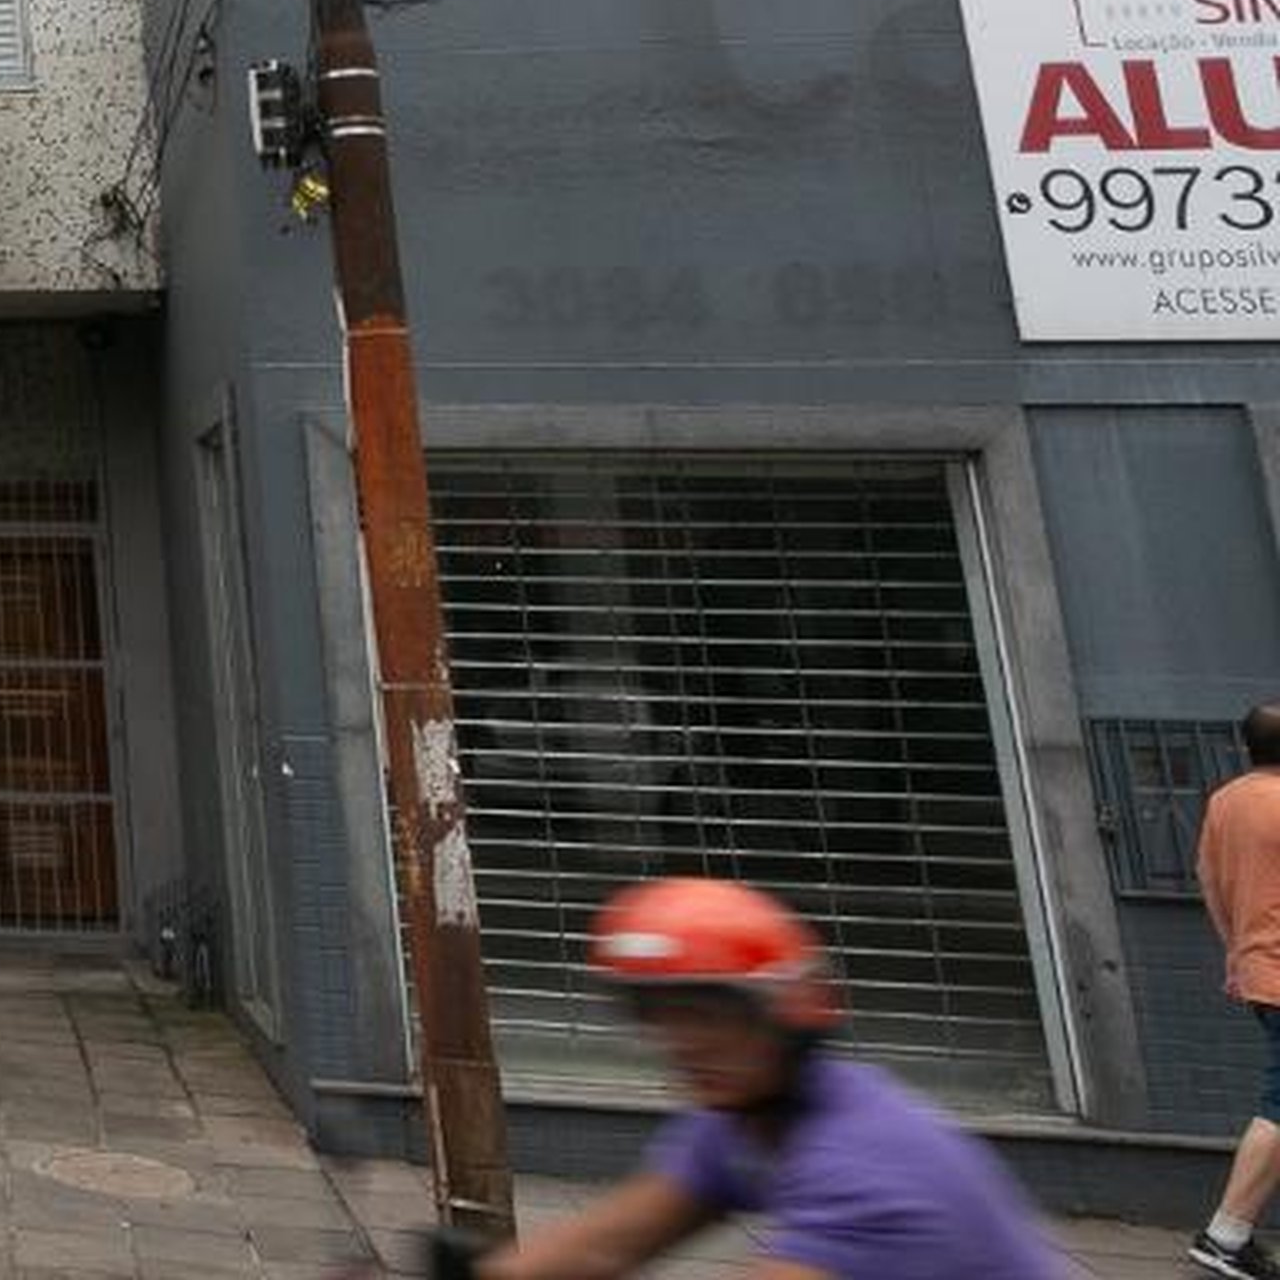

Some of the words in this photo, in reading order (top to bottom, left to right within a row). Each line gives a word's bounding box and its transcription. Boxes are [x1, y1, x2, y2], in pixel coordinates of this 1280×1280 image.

[1019, 55, 1280, 153] ALU
[1040, 165, 1280, 233] 9973
[1153, 288, 1277, 315] ACESSE
